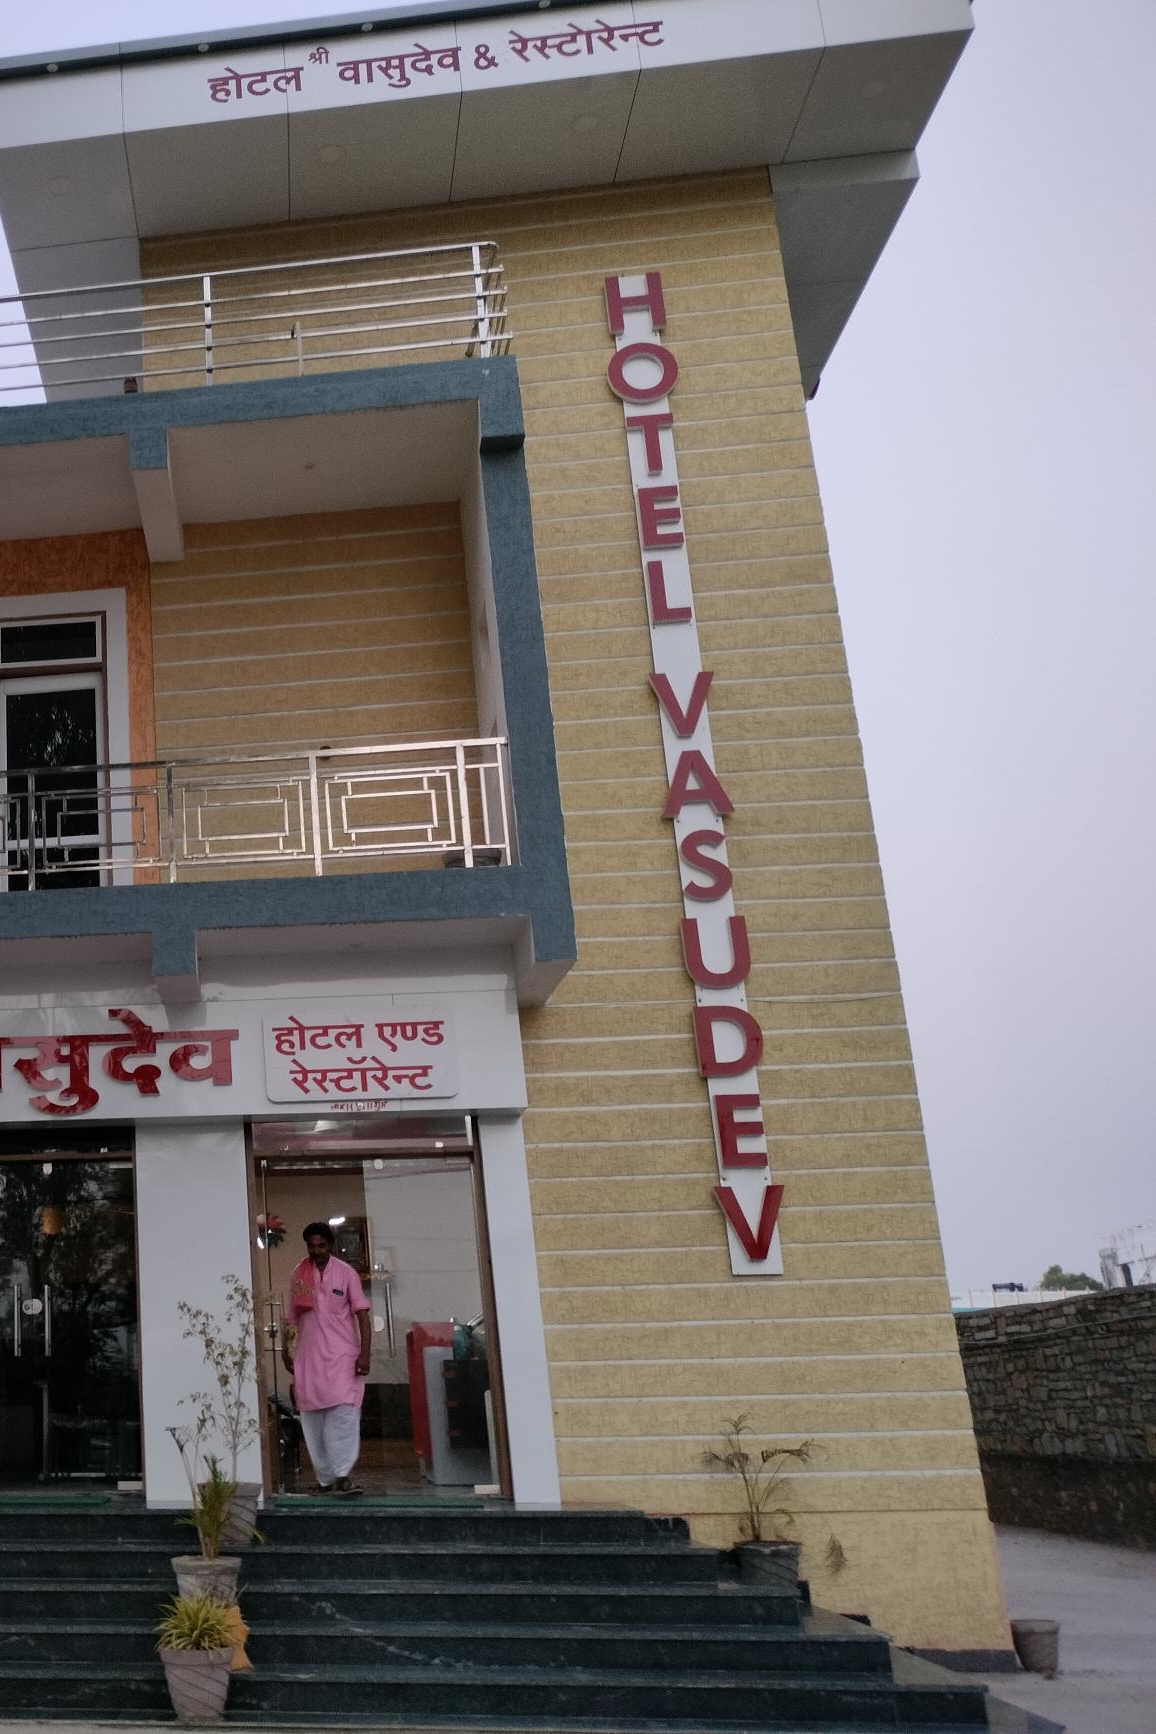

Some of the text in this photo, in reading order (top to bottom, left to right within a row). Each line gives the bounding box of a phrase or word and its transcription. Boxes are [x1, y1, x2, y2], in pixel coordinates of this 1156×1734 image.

[208, 19, 665, 103] होटल श्री वासुदेव & रेस्टोरेन्ट
[604, 271, 784, 1261] HOTEL VASUDEV
[272, 1015, 445, 1056] होटल एण्ड
[289, 1055, 434, 1095] रेस्टॉरेन्ट
